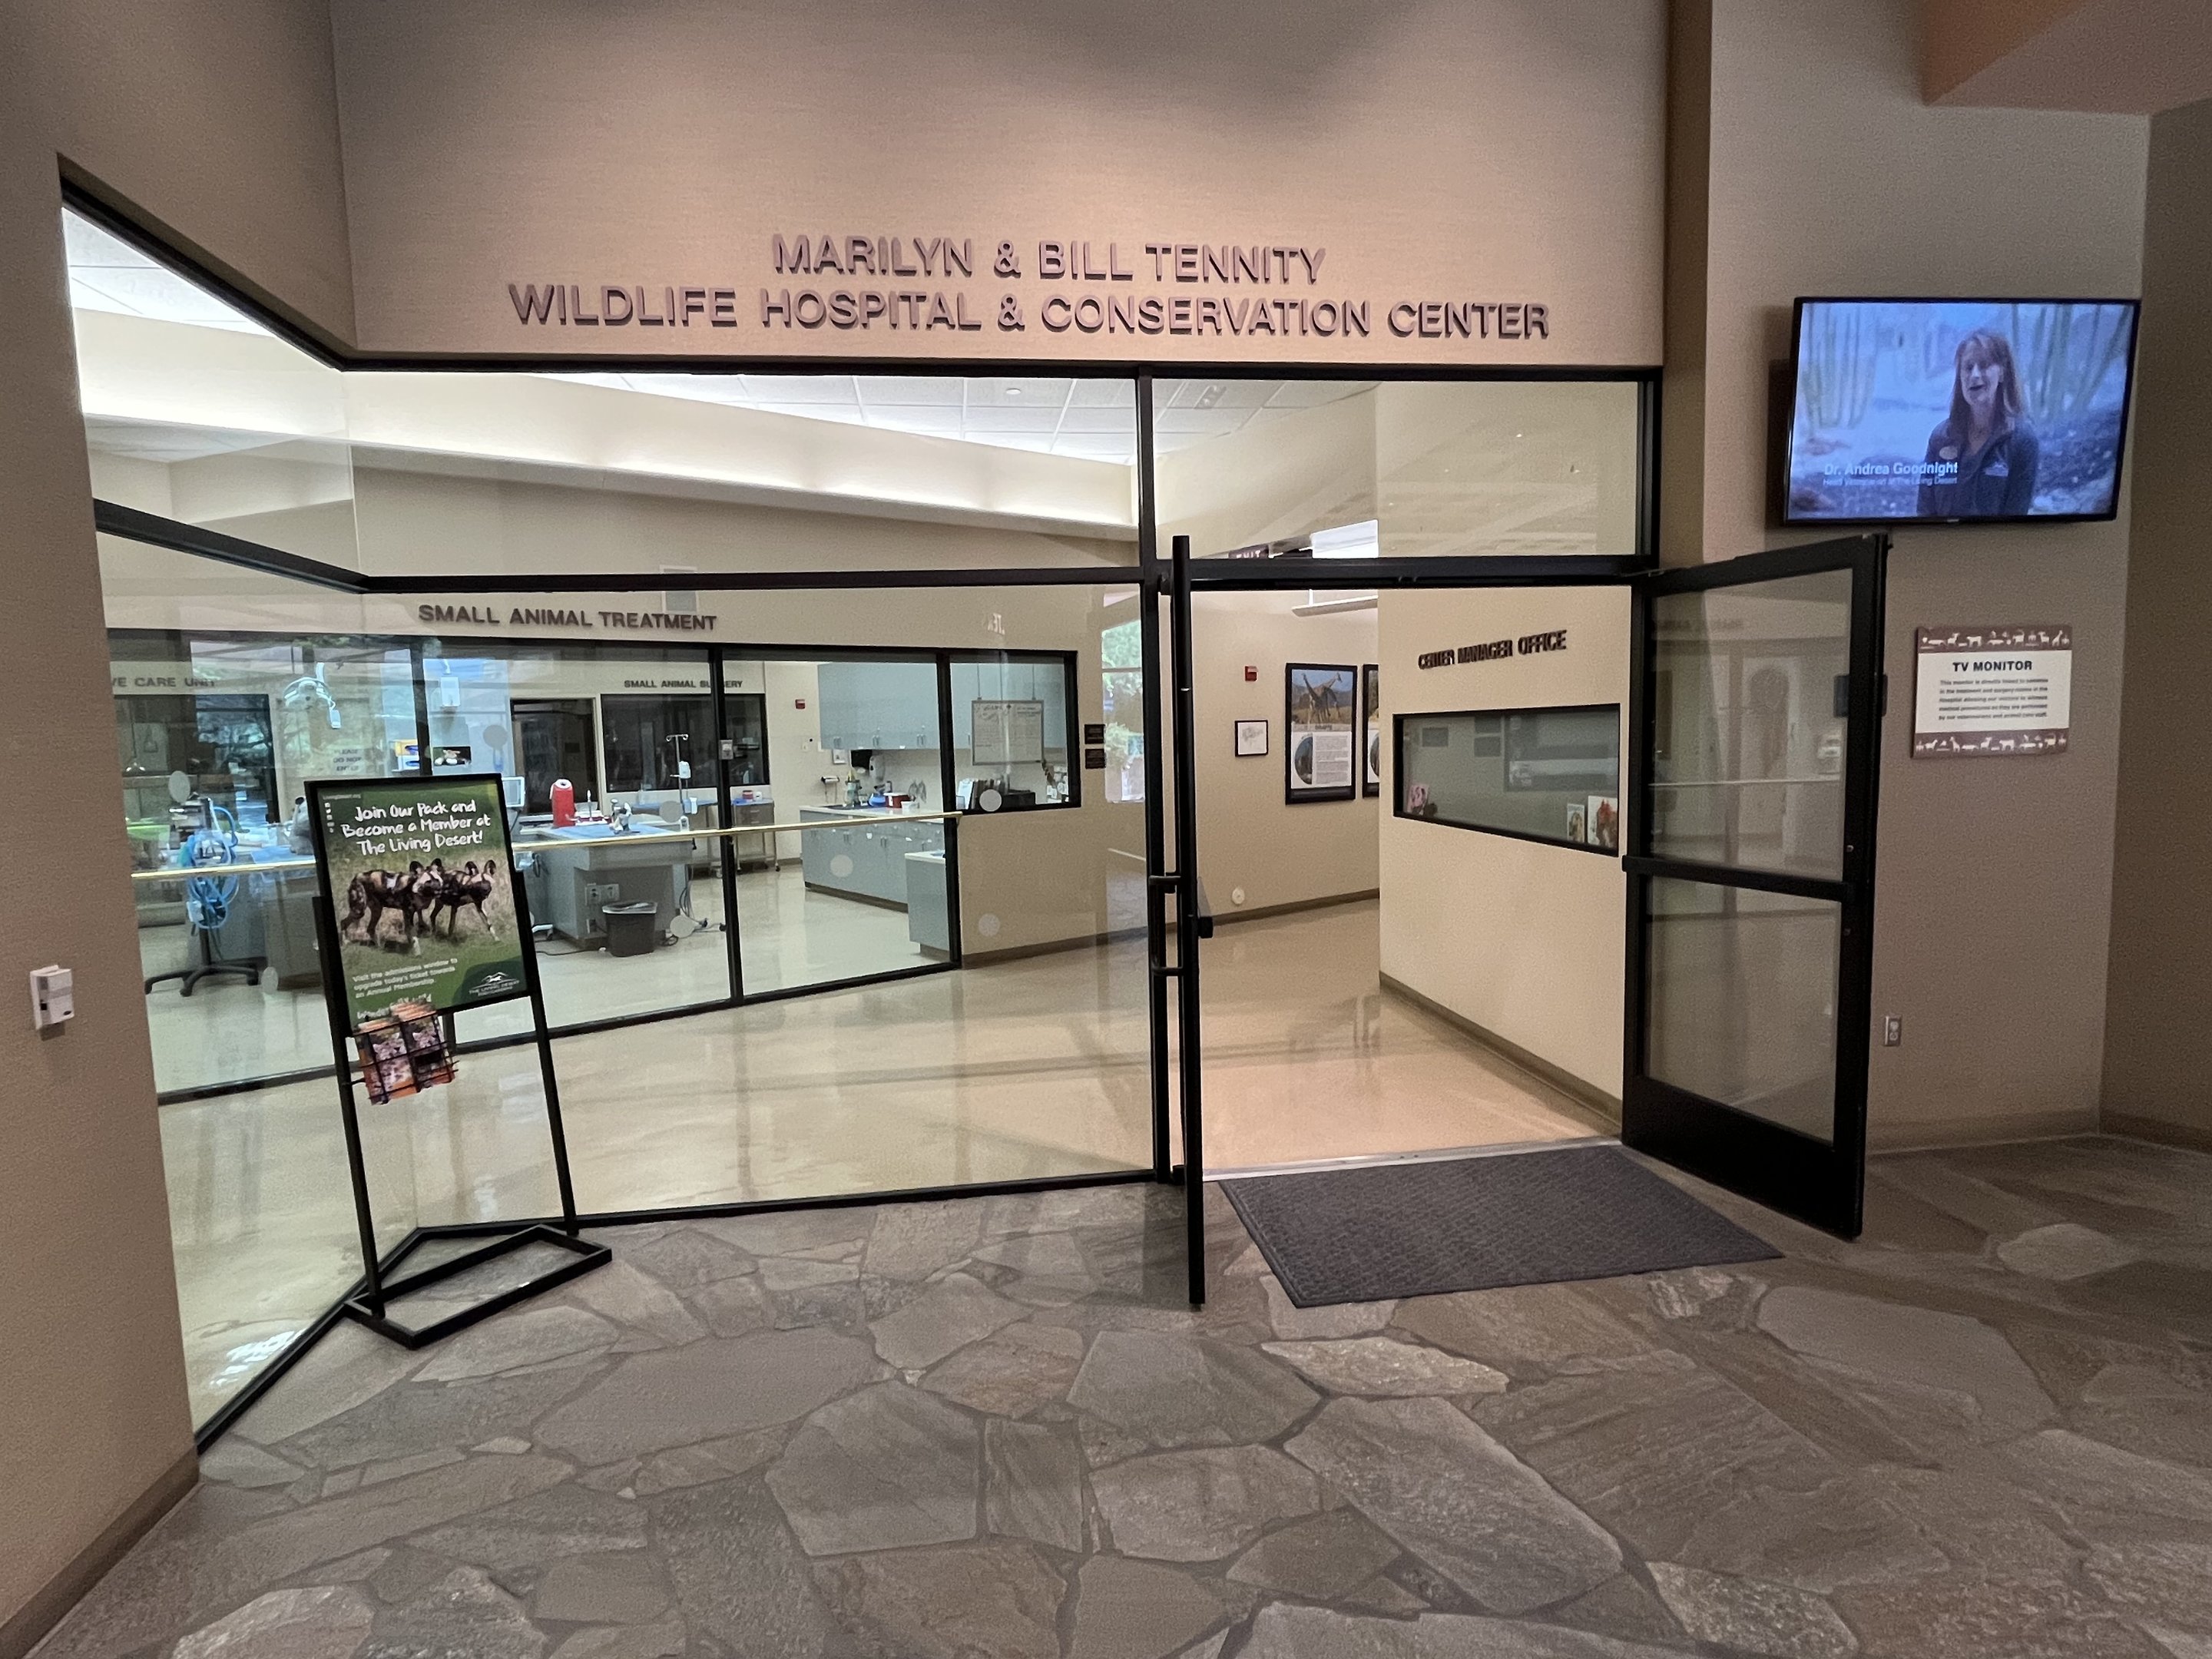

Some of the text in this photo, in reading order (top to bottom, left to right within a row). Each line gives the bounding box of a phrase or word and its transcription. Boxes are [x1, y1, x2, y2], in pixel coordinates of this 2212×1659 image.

[772, 233, 1326, 285] MARILYN & BILL TENNITY
[508, 283, 1550, 339] WILDLIFE HOSPITAL & CONSERVATION CENTER
[1824, 462, 1958, 476] Dr. Andrea Goodnight
[419, 604, 717, 631] SMALL ANIMAL TREATMENT
[1458, 640, 1513, 664] MANAGER
[1518, 630, 1567, 654] OFFICE
[1952, 661, 2032, 672] TV MONITOR
[134, 677, 177, 687] CARE
[624, 680, 657, 688] SMALL
[661, 680, 696, 688] ANIMAL
[355, 799, 476, 822] Join Our Pack and
[340, 813, 491, 839] Become a Member at
[356, 830, 483, 856] The Living Desert!
